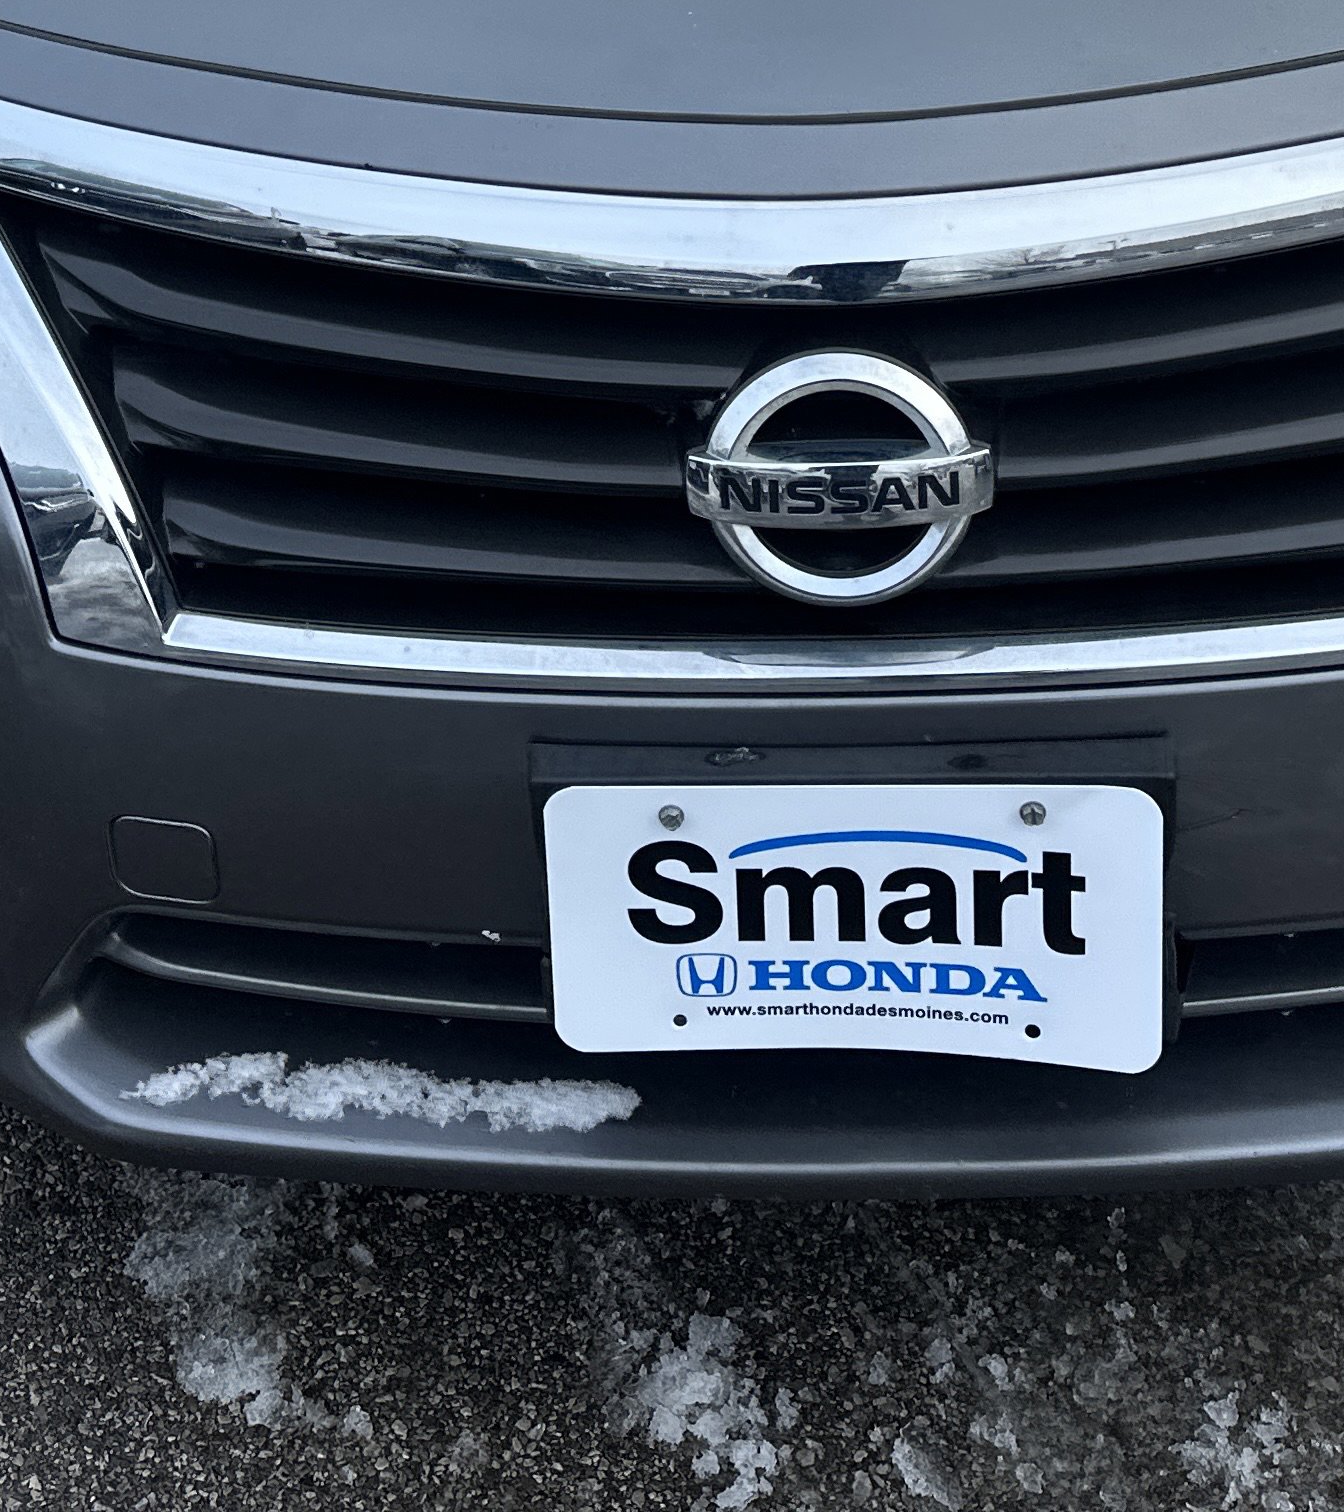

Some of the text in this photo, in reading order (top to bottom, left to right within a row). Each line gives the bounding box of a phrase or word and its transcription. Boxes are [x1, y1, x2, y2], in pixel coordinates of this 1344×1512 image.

[718, 471, 961, 515] NISSAN
[627, 840, 1086, 955] Smart
[748, 959, 1048, 1002] HONDA
[706, 1002, 1009, 1025] www.smarthondadesmoines.com
